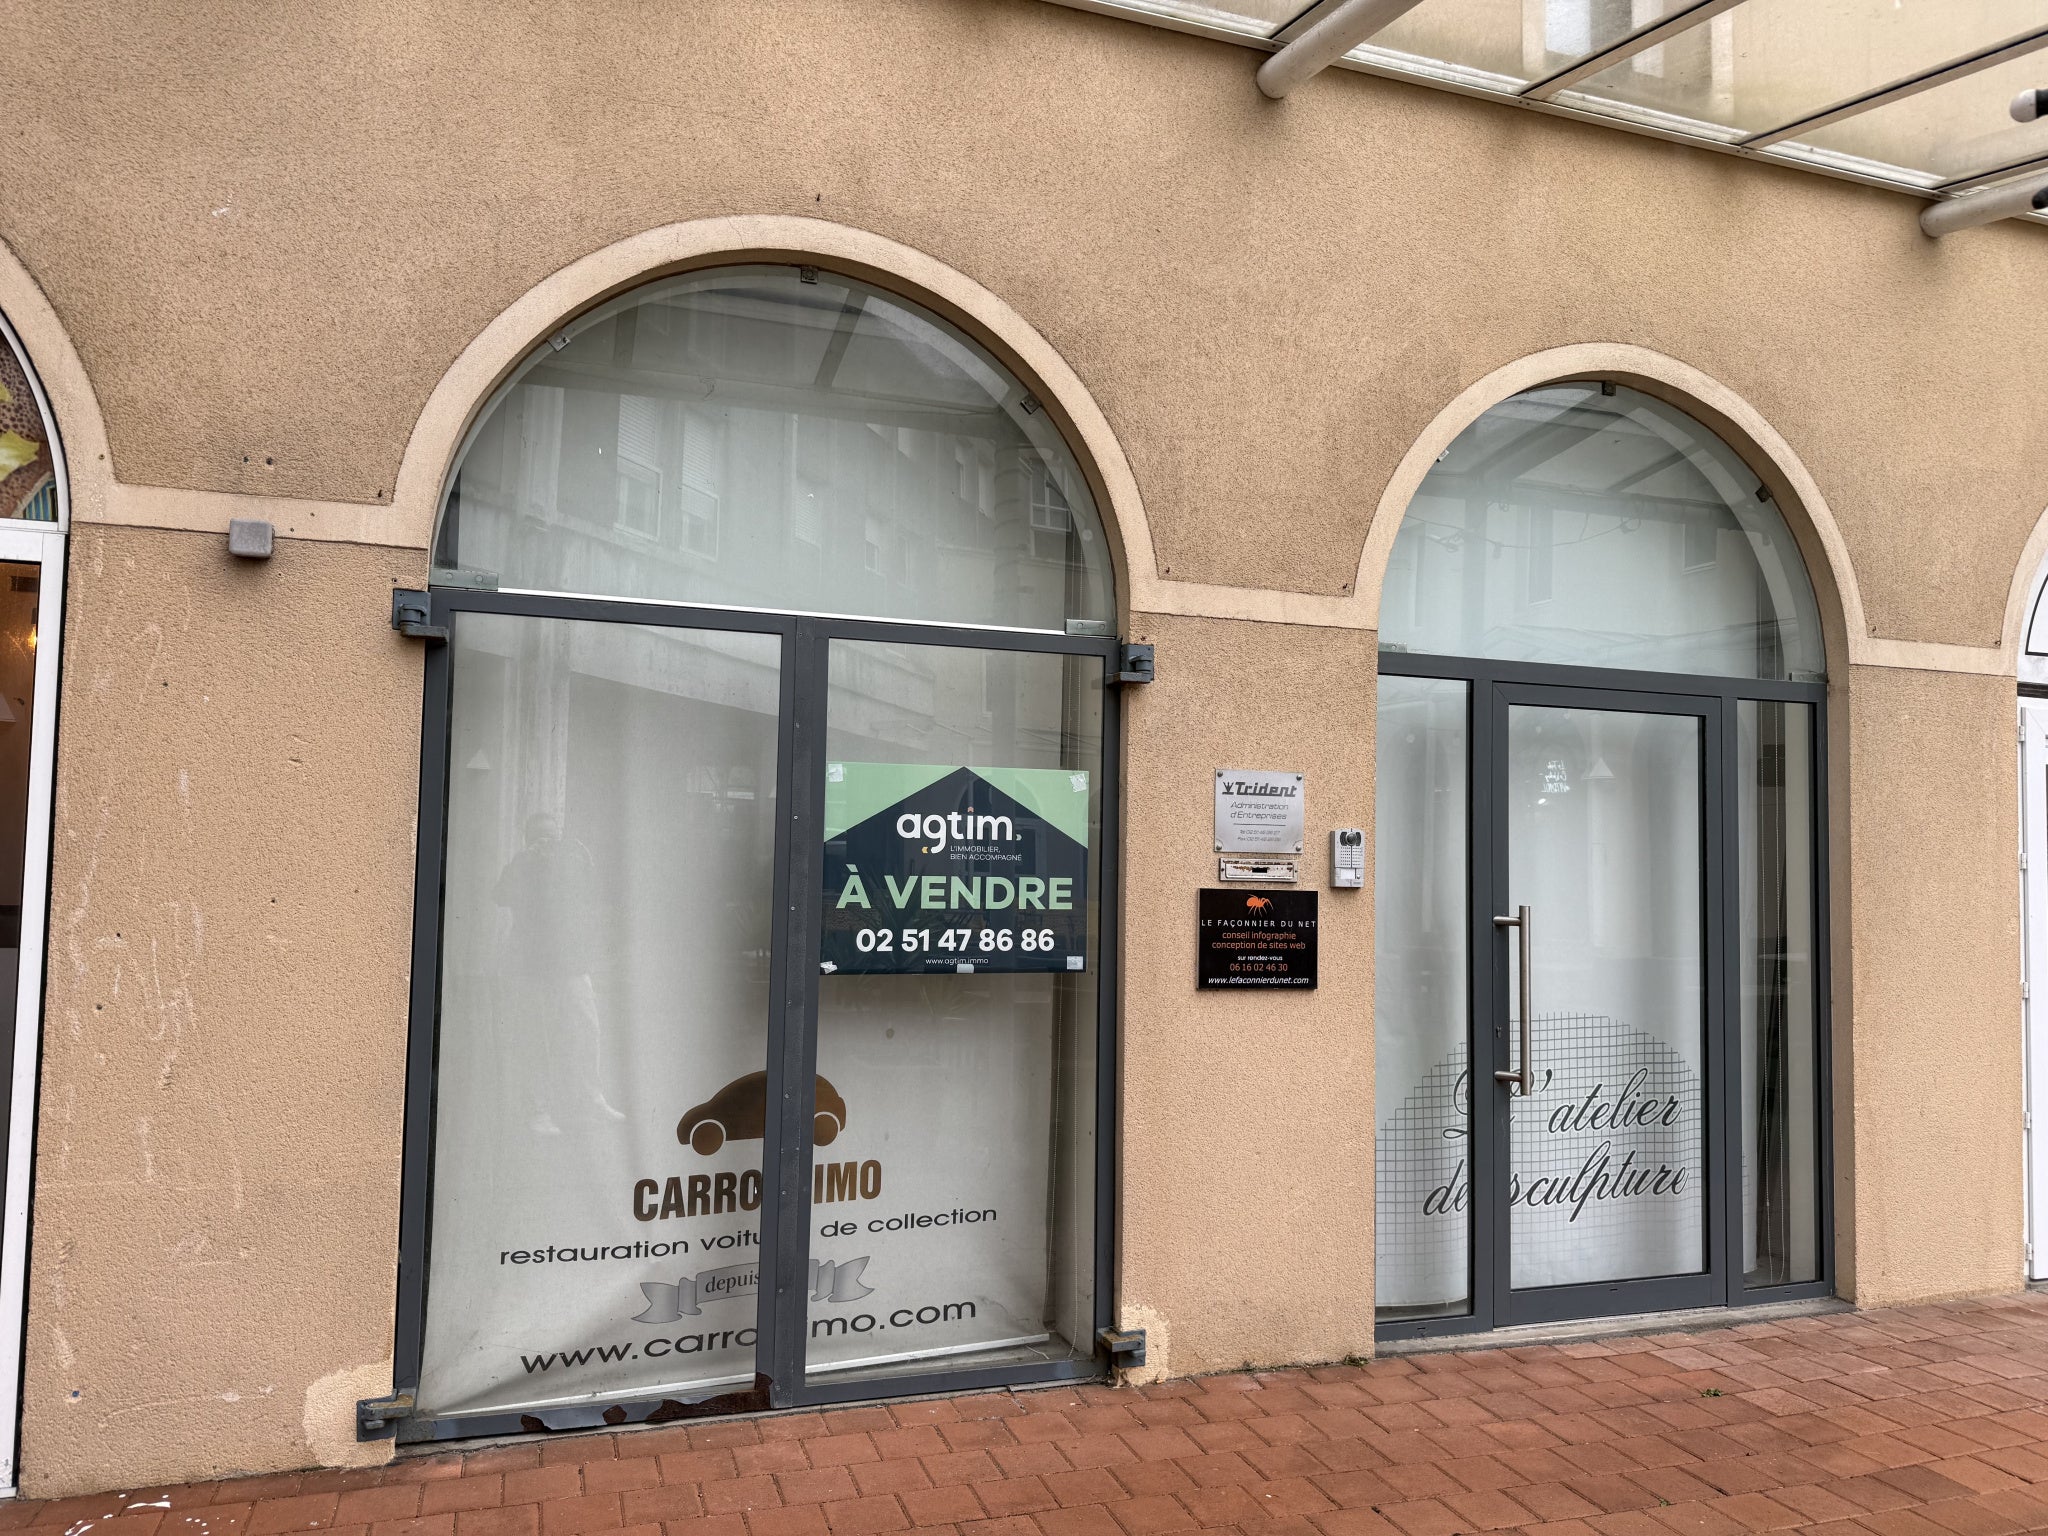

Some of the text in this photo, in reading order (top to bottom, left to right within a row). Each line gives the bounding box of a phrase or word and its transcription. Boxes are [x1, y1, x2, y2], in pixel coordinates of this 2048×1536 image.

[1235, 782, 1297, 798] Trident
[1230, 801, 1289, 811] Administration
[1230, 811, 1287, 820] d'Entreprises
[836, 863, 1073, 910] À VENDRE
[1201, 919, 1213, 927] LE
[1217, 919, 1275, 928] FAÇONNIER
[1298, 920, 1316, 928] NET
[856, 928, 1055, 952] 02 51 47 86 86
[1222, 931, 1297, 941] conseil infographie
[1211, 941, 1306, 951] conception de sites web
[1229, 963, 1289, 972] 06 16 02 46 30
[1208, 976, 1309, 985] www.lefaconnierdunet.com
[1510, 1140, 1689, 1222] sculpture
[633, 1160, 882, 1222] CARROIMO
[500, 1237, 689, 1265] restauration
[820, 1221, 858, 1237] de
[867, 1206, 998, 1233] collection
[520, 1300, 976, 1374] www.carromo.com
